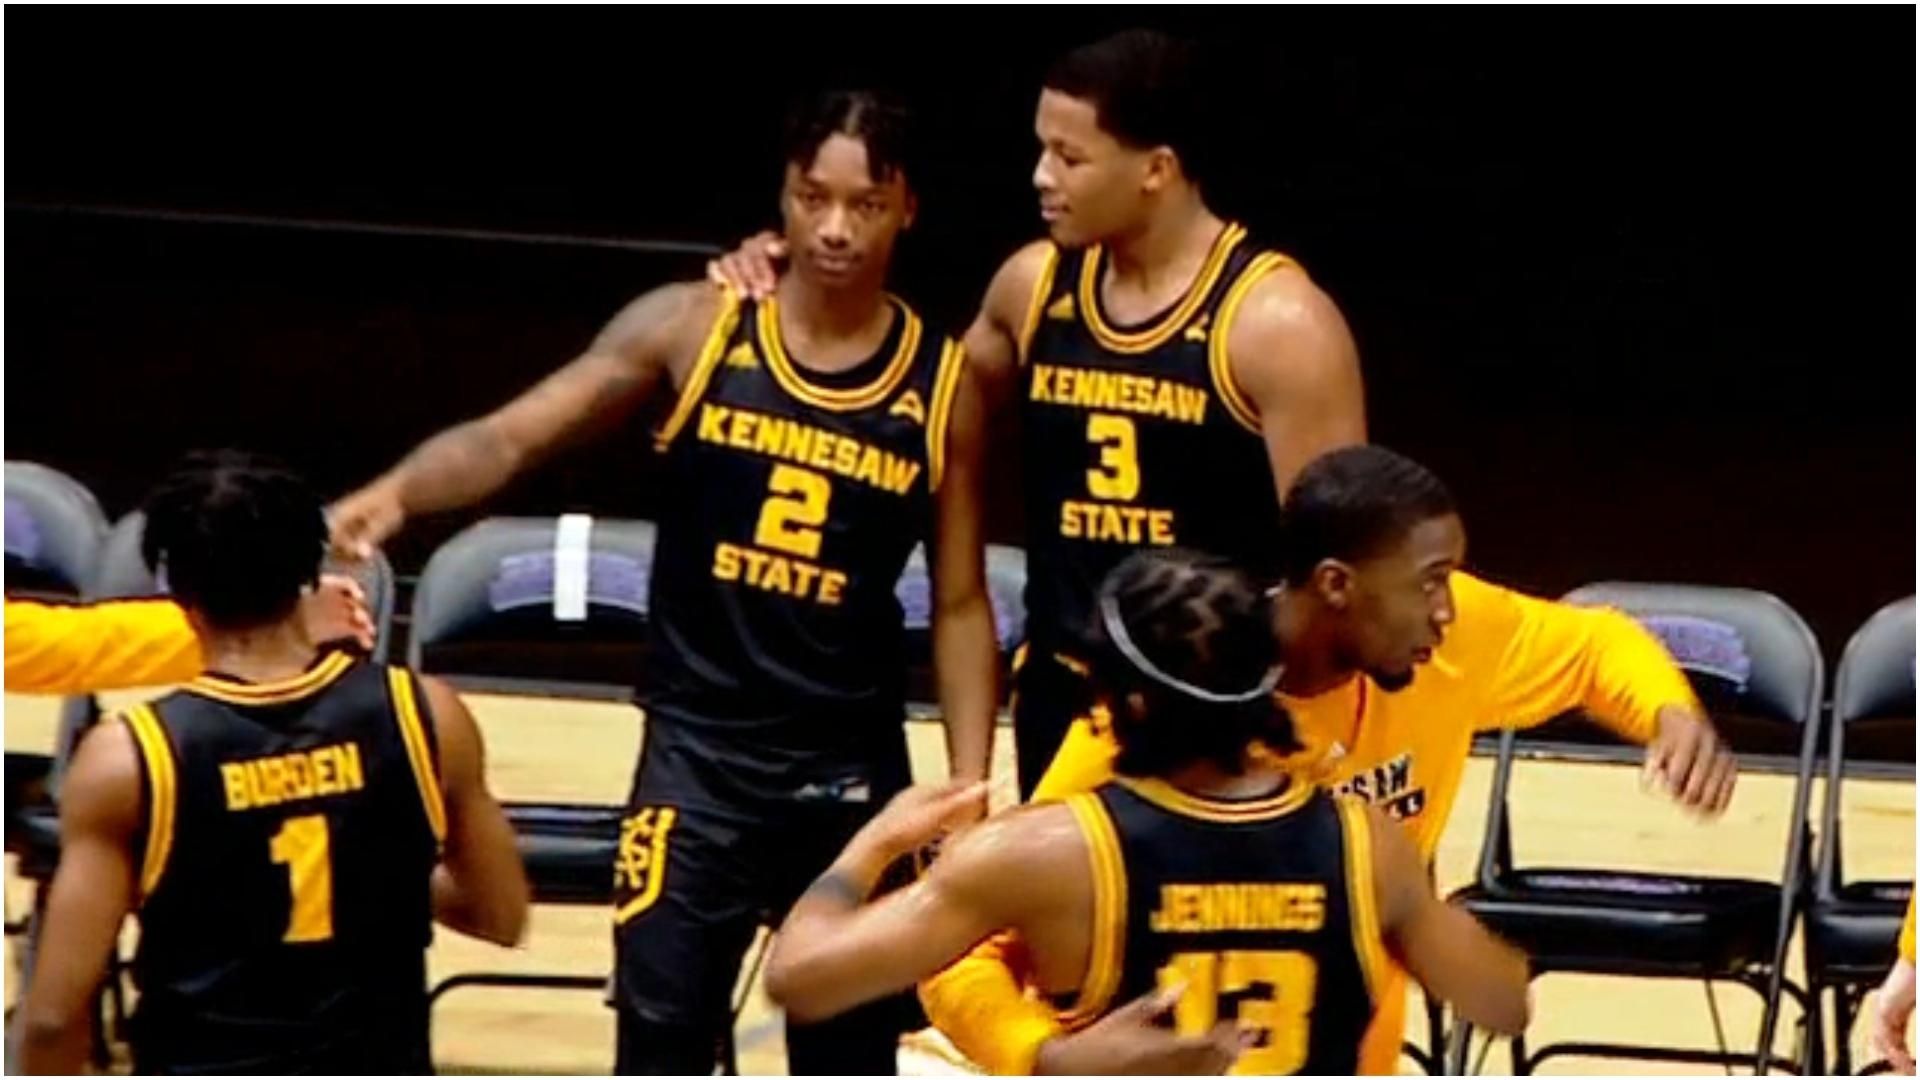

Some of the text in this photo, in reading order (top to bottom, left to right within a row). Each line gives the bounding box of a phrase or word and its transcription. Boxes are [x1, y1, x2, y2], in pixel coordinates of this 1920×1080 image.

[1030, 364, 1208, 425] KENNESAW
[697, 403, 921, 494] KENNESAW
[1086, 413, 1140, 501] 3
[754, 462, 832, 558] 2
[1060, 501, 1175, 545] STATE
[712, 542, 847, 605] STATE
[219, 742, 364, 811] BURDEN
[269, 814, 334, 942] 1
[1156, 950, 1317, 1076] 13
